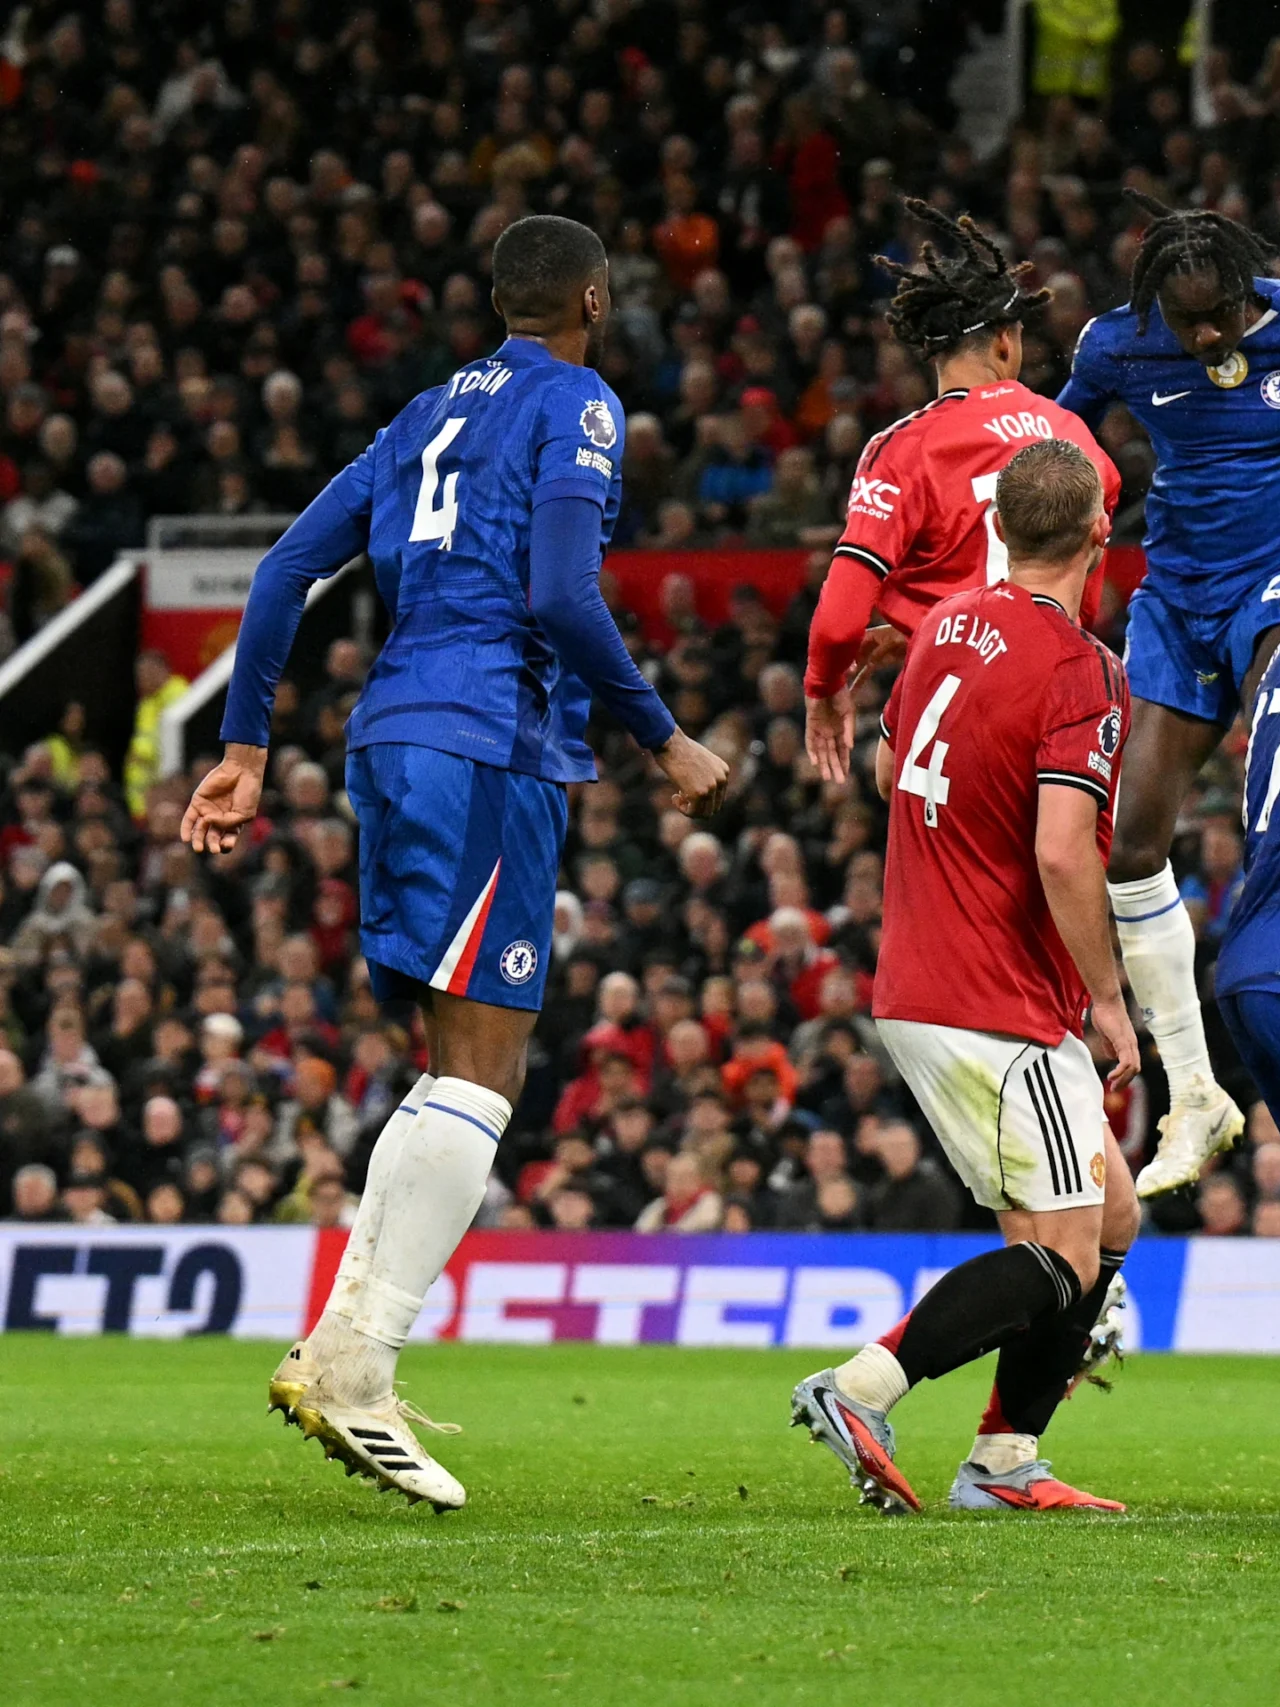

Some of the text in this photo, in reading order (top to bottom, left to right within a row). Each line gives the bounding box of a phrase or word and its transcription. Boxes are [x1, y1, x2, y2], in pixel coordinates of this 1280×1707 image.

[982, 411, 1054, 443] YORO
[408, 416, 468, 551] 4
[934, 614, 1008, 666] DE LIGT
[897, 673, 962, 829] 4
